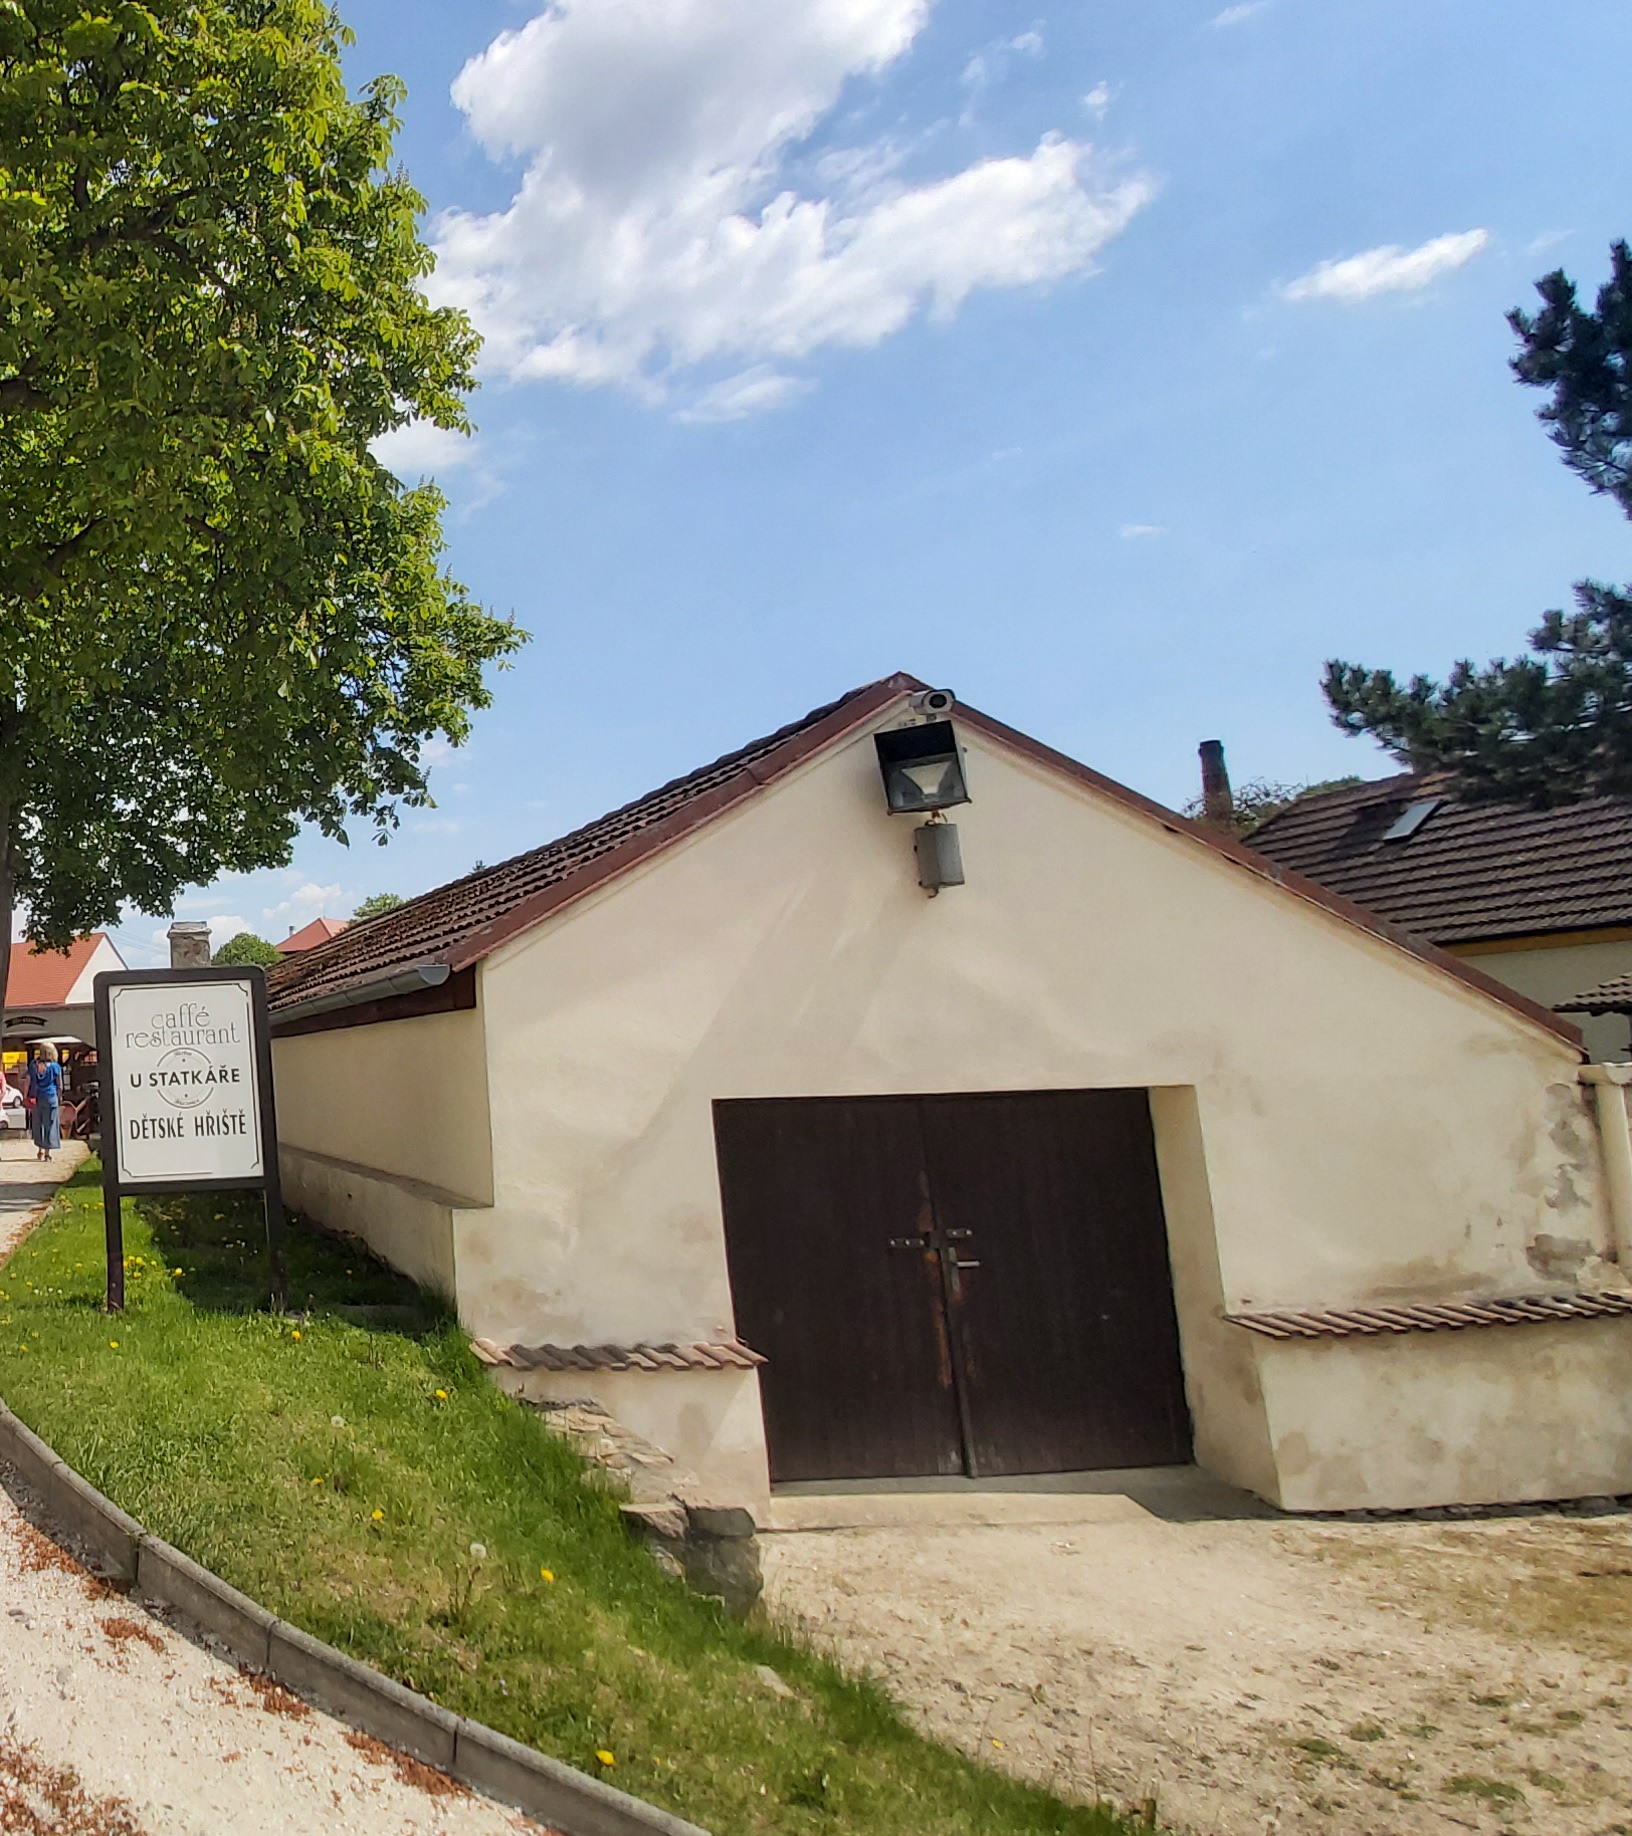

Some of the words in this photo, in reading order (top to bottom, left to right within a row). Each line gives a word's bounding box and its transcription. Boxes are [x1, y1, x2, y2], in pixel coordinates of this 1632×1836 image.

[151, 1003, 211, 1029] caffé
[125, 1022, 241, 1048] restaurant
[130, 1073, 142, 1088] U
[149, 1065, 240, 1087] STATKÁŘE
[130, 1111, 185, 1140] DĚTSKÉ
[194, 1108, 247, 1137] HŘIŠTĚ
